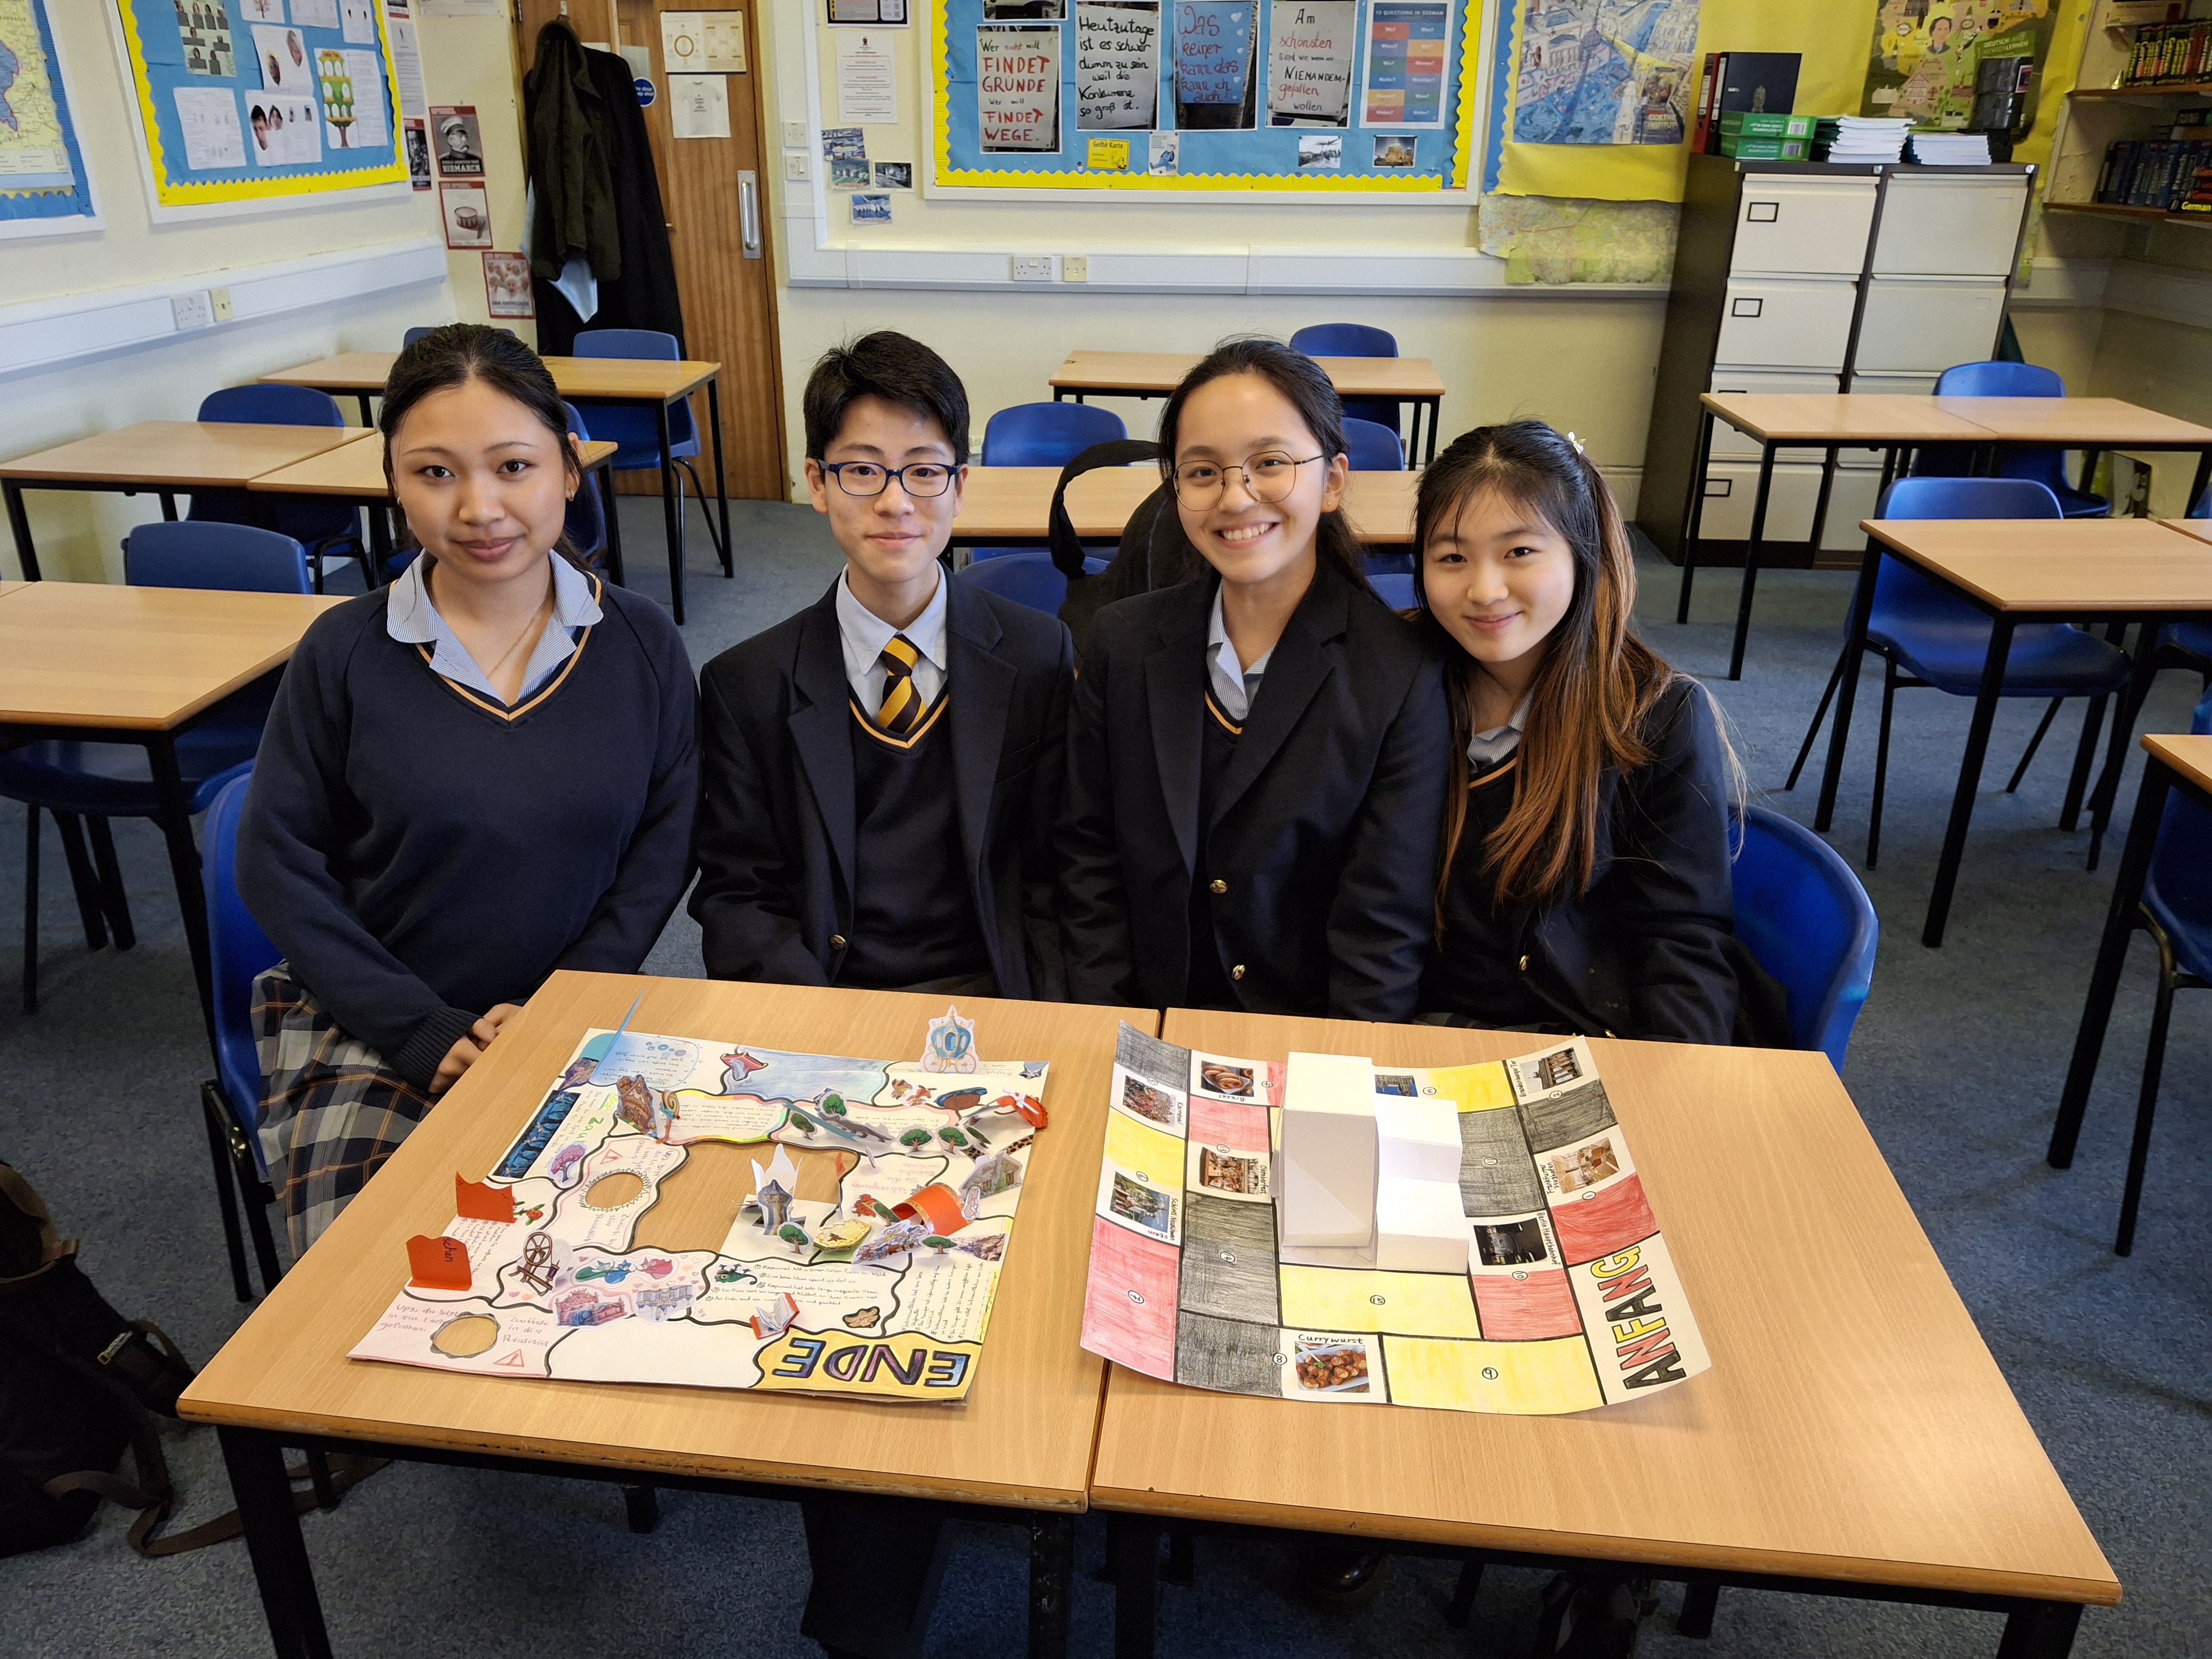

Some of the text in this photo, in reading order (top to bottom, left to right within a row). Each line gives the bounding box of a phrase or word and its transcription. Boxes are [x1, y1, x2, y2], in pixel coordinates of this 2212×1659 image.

[1175, 5, 1220, 36] Was
[1295, 8, 1315, 24] Am
[1079, 16, 1154, 44] Heutzutage
[979, 38, 1000, 52] Wer
[1026, 40, 1040, 50] will
[1079, 36, 1152, 52] ist es schwer
[1182, 35, 1224, 59] keiner
[982, 55, 1050, 74] FINDET
[1079, 56, 1149, 69] dumm zu sein
[1179, 57, 1238, 75] kann das
[1092, 70, 1131, 81] weil die
[1180, 76, 1210, 92] kann
[1278, 81, 1319, 101] gefallen
[1079, 107, 1091, 117] so
[1095, 102, 1115, 119] groß
[1293, 100, 1322, 111] wollen
[982, 108, 1044, 124] FINDET
[984, 127, 1040, 142] WEGE.
[2181, 201, 2211, 211] German
[1259, 1165, 1269, 1194] Oktoberfest
[1171, 1197, 1179, 1216] Schloss
[1536, 1212, 1561, 1265] Berlin Hauptbahnhof
[1222, 1252, 1233, 1261] 14
[1372, 1296, 1384, 1304] 15
[1590, 1245, 1687, 1390] ANFANG
[771, 1337, 971, 1388] ENDE
